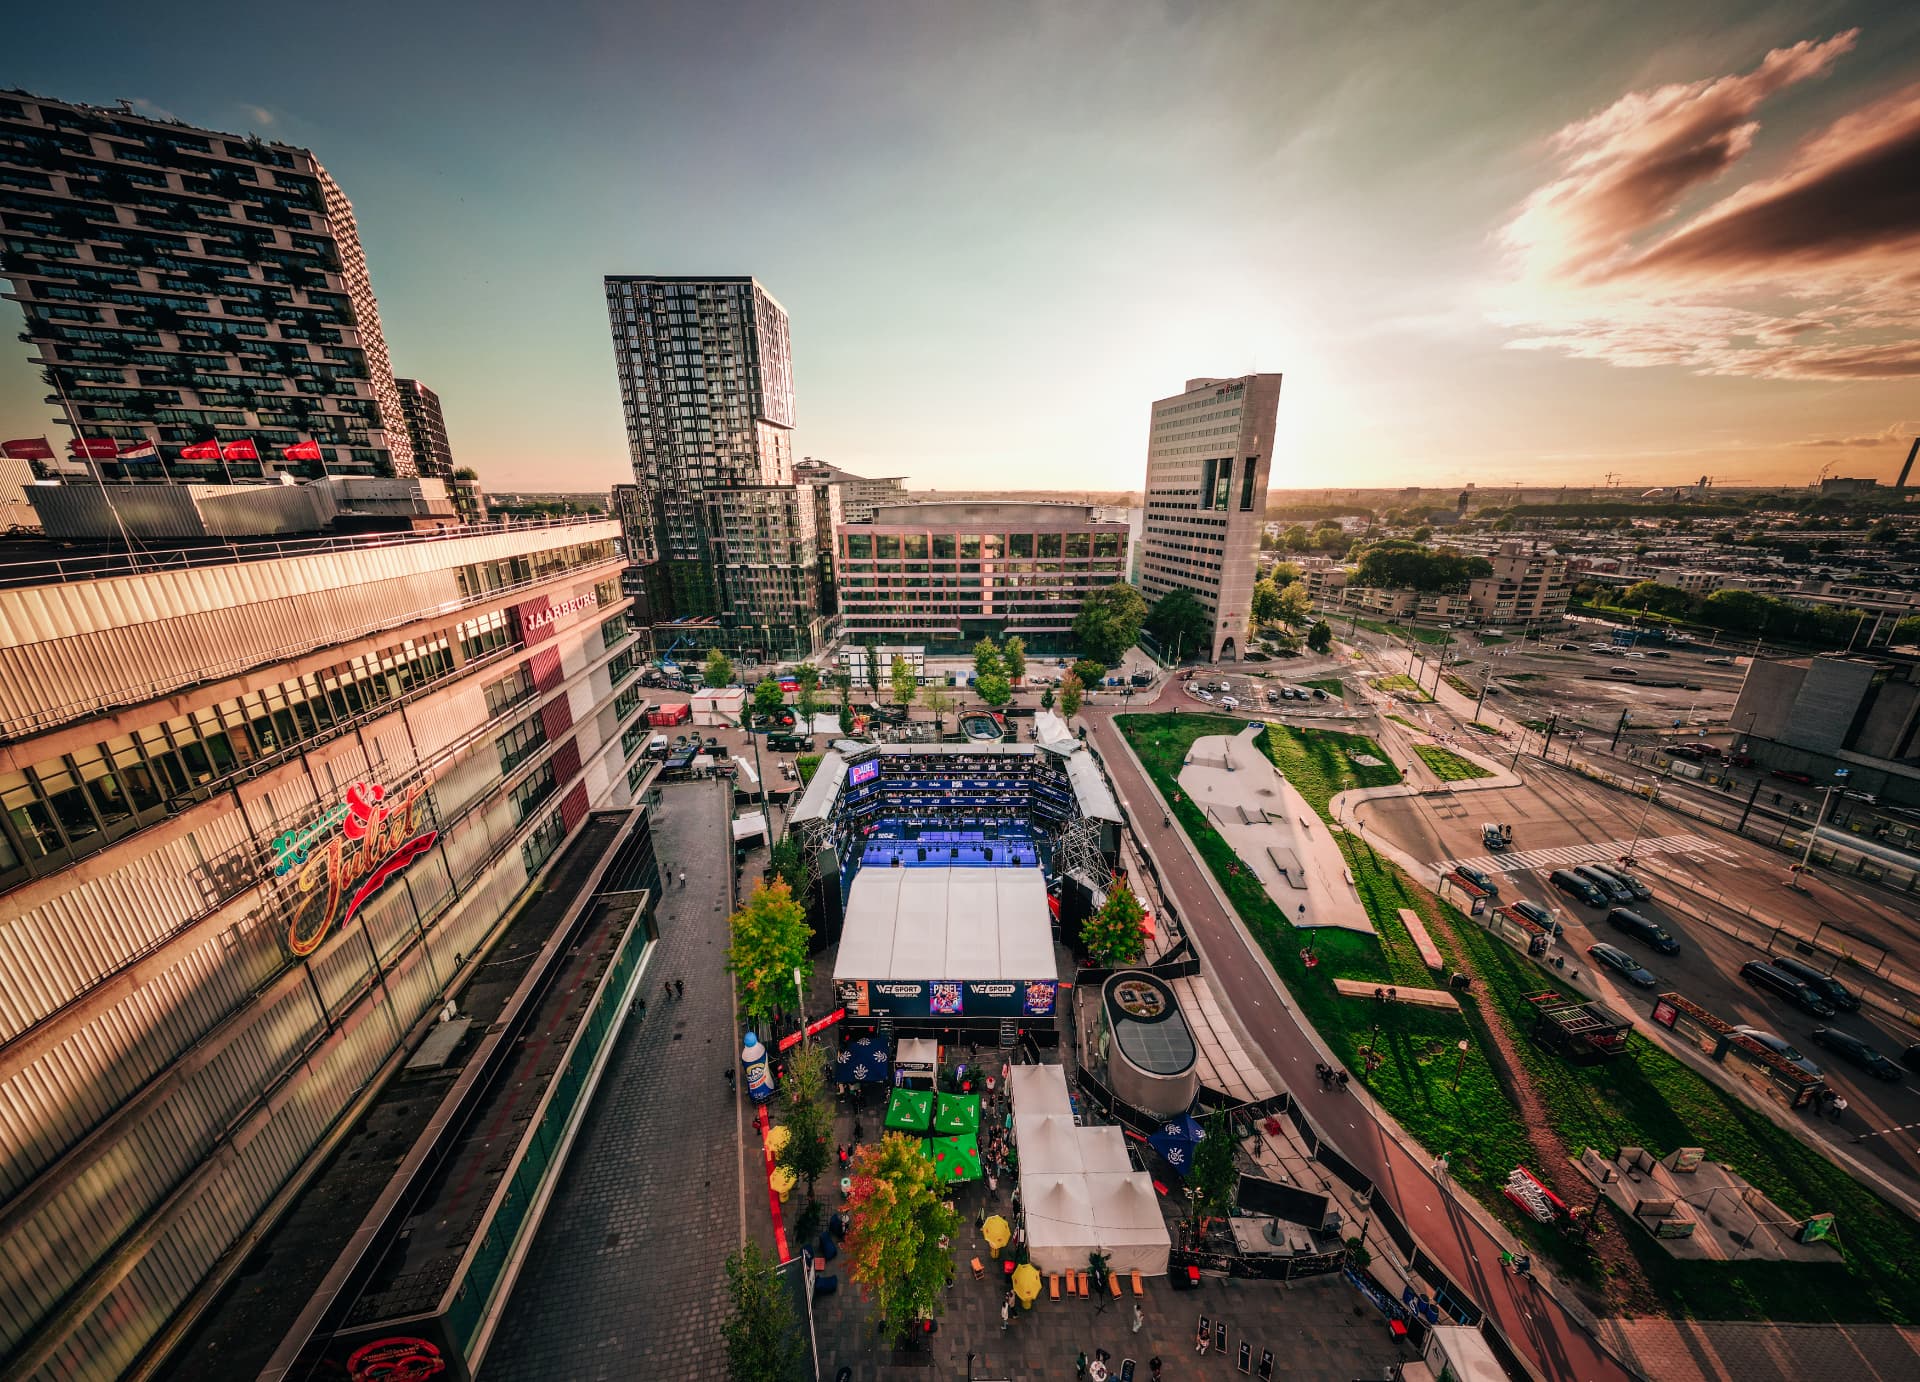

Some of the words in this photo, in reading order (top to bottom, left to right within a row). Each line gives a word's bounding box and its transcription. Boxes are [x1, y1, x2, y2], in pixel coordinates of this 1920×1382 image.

[528, 592, 597, 630] JAARBEURS
[289, 780, 433, 957] Juliet
[894, 984, 922, 994] SPORT
[985, 984, 1016, 994] SPORT
